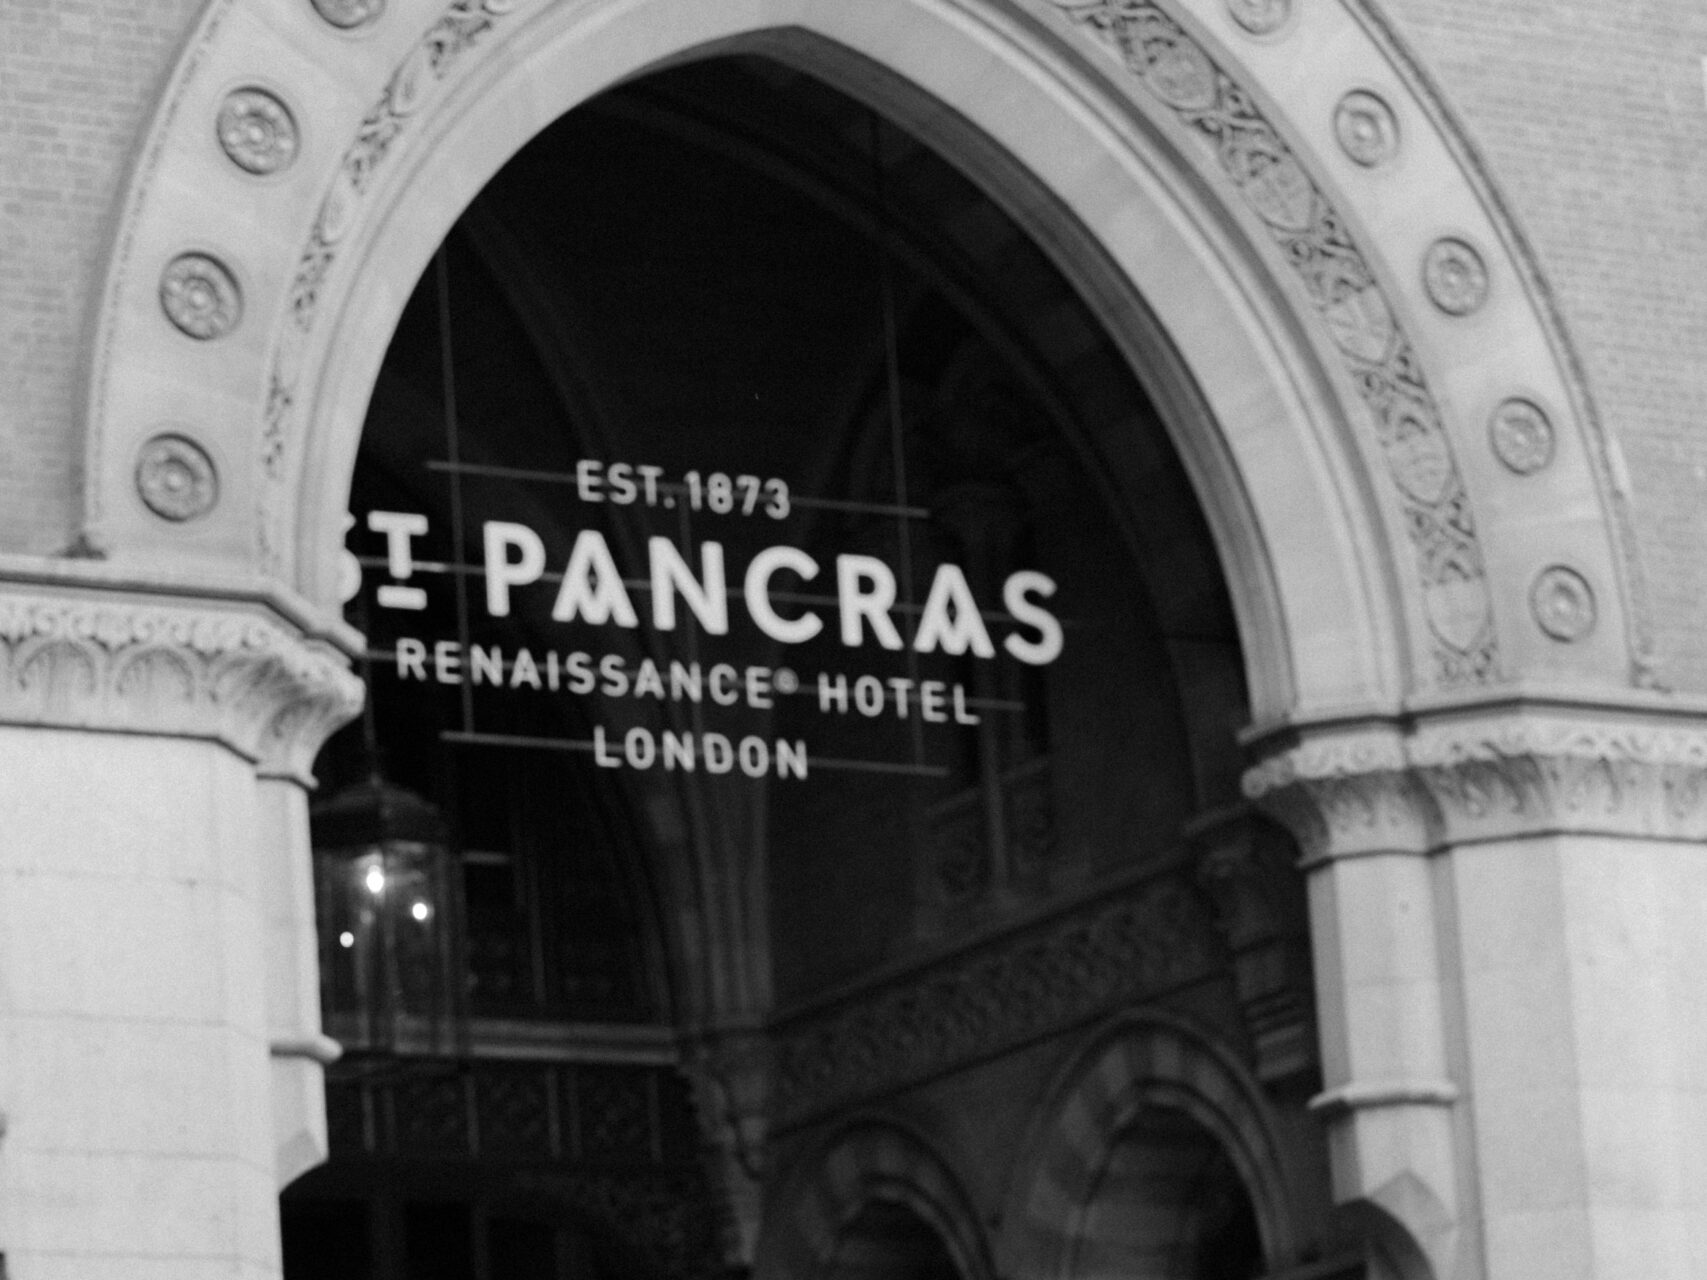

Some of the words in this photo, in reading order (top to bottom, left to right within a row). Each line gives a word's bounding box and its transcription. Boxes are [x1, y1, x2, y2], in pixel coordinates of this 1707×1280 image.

[344, 509, 429, 611] T
[482, 519, 1064, 666] PANCRAS
[817, 671, 981, 726] HOTEL
[593, 725, 809, 780] LONDON
